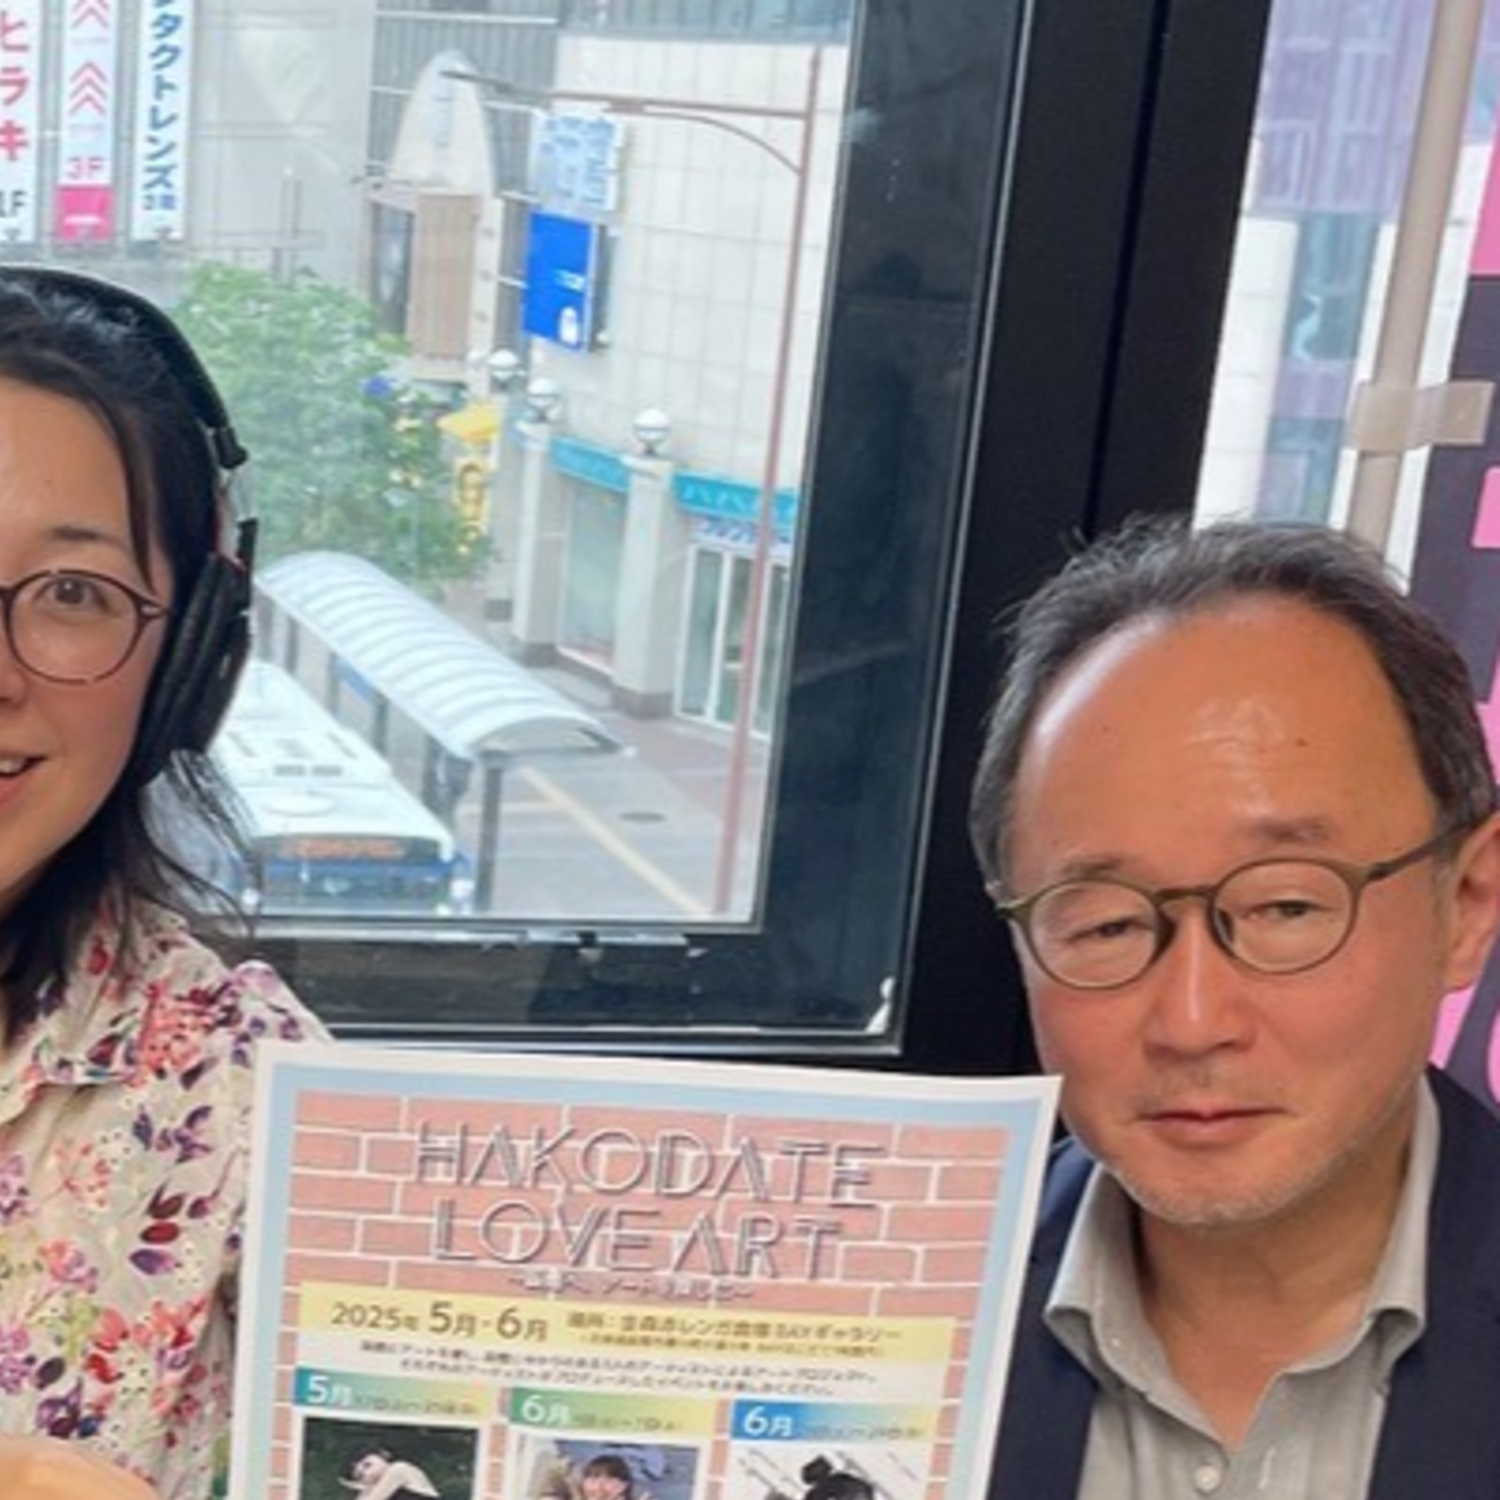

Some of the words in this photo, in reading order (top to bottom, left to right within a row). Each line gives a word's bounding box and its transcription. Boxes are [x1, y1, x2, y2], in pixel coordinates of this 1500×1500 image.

[142, 0, 182, 190] タクトレンズ
[415, 1120, 887, 1208] HAKODATE
[430, 1198, 661, 1271] LOVE
[671, 1211, 843, 1280] ART
[307, 1375, 352, 1407] 5月
[520, 1394, 571, 1425] 6月
[742, 1405, 793, 1438] 6月
